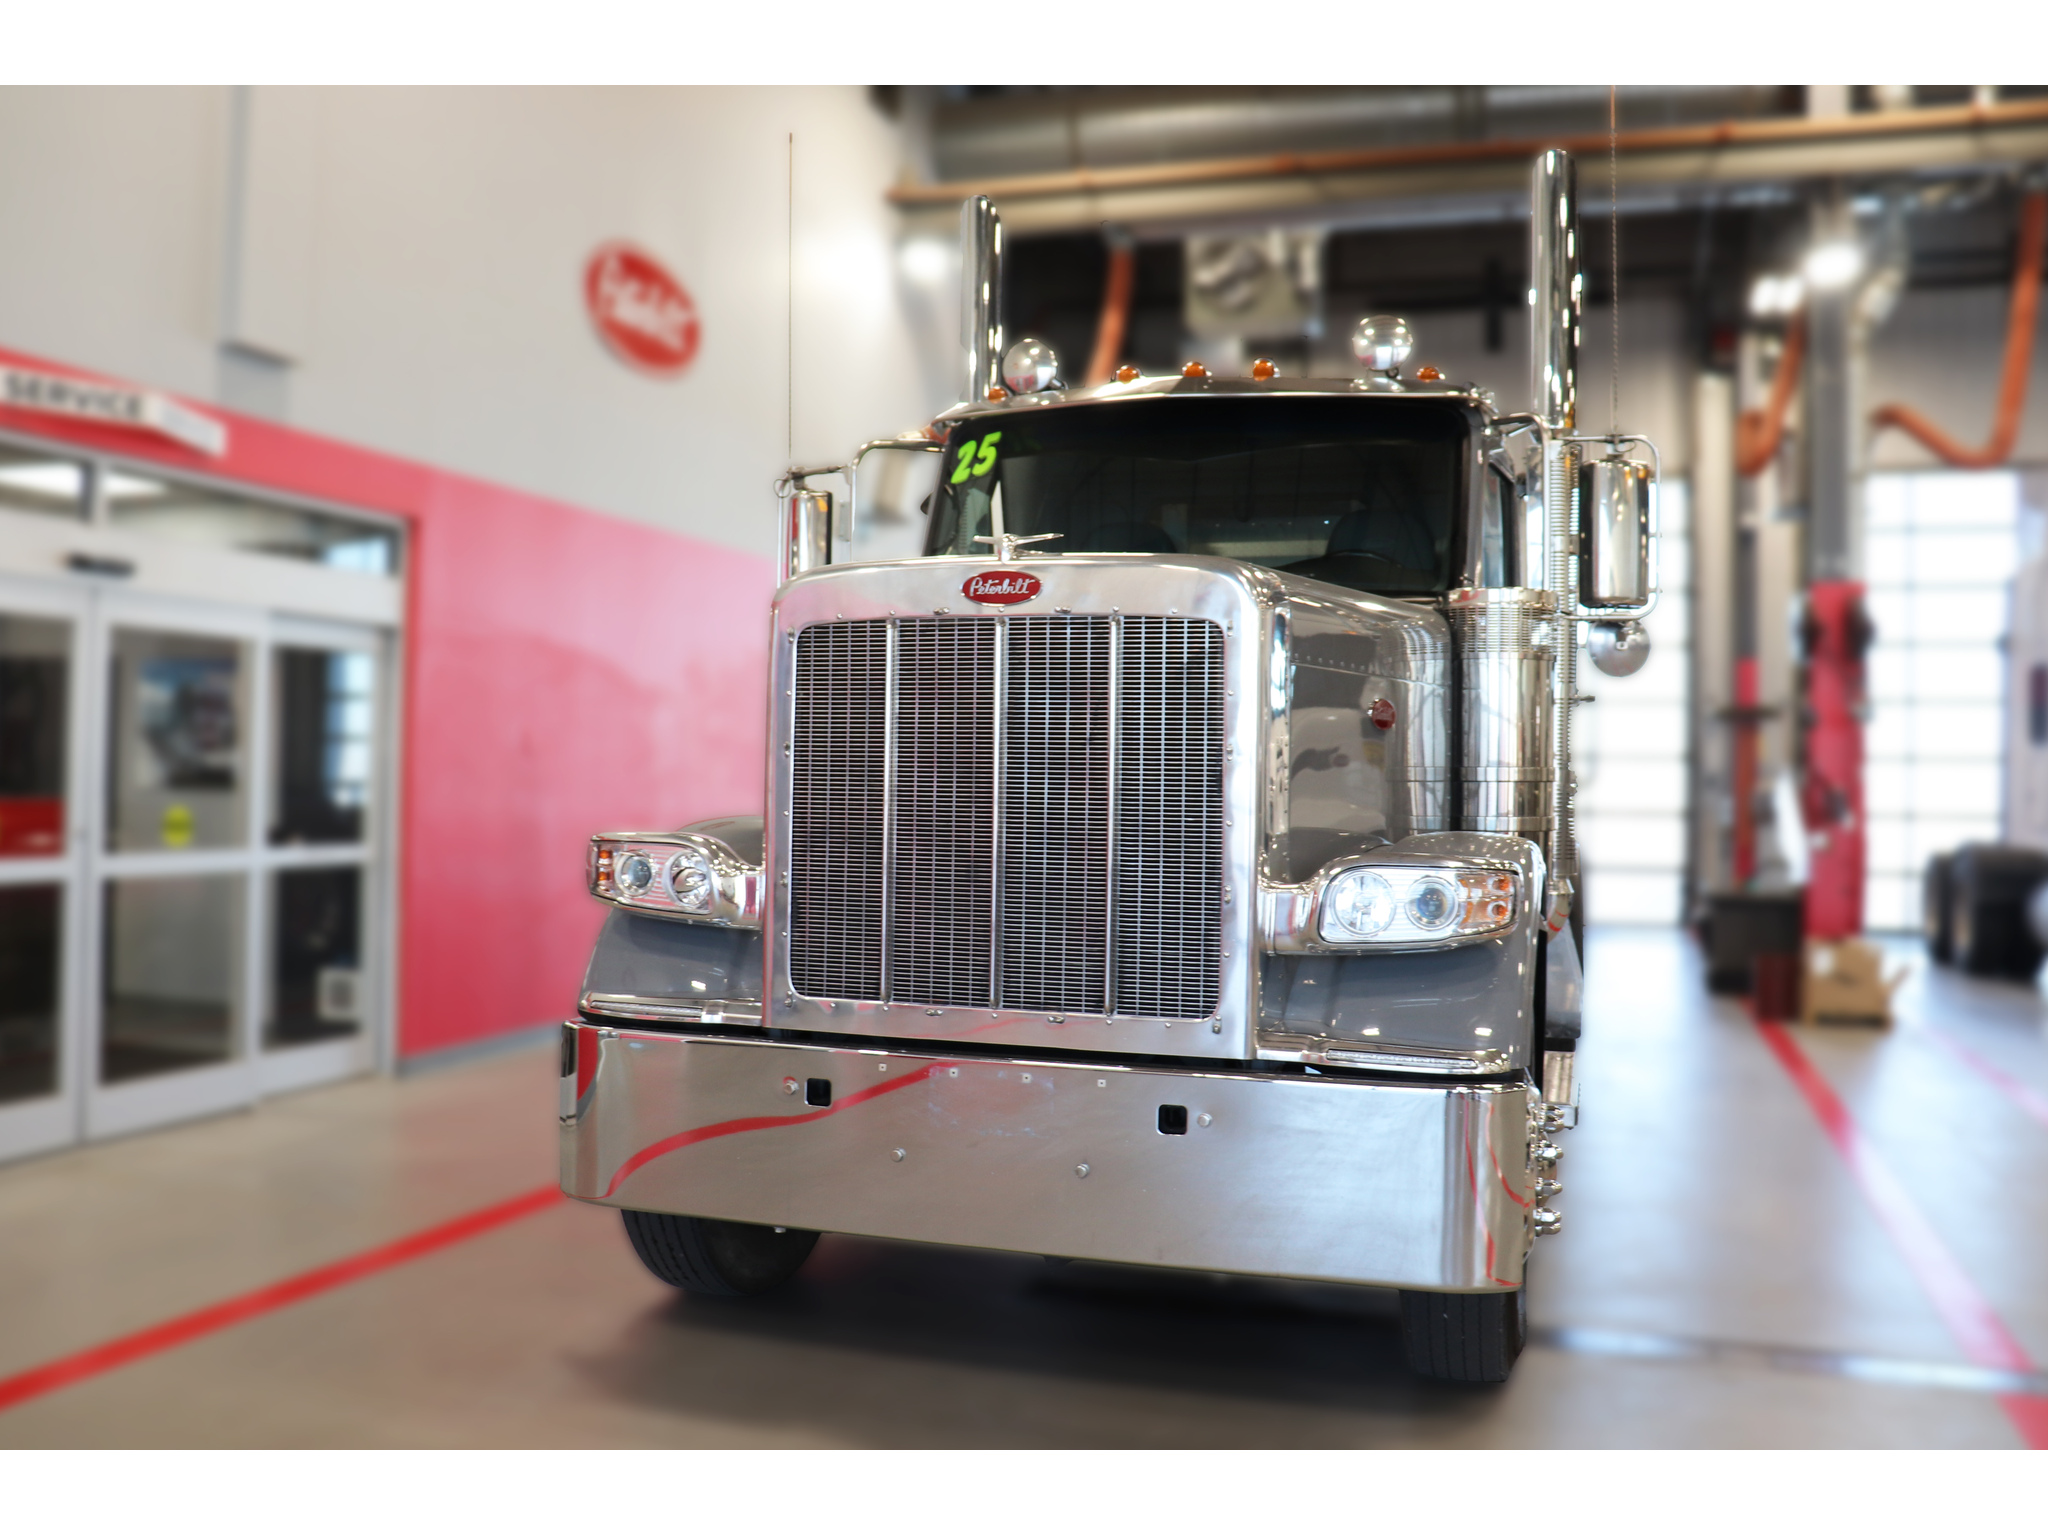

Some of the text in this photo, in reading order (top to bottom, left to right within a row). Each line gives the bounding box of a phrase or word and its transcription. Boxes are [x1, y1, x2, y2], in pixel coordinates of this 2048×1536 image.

[4, 371, 142, 420] SERVICE
[951, 431, 1002, 484] 25
[969, 577, 1036, 597] Peterbilt
